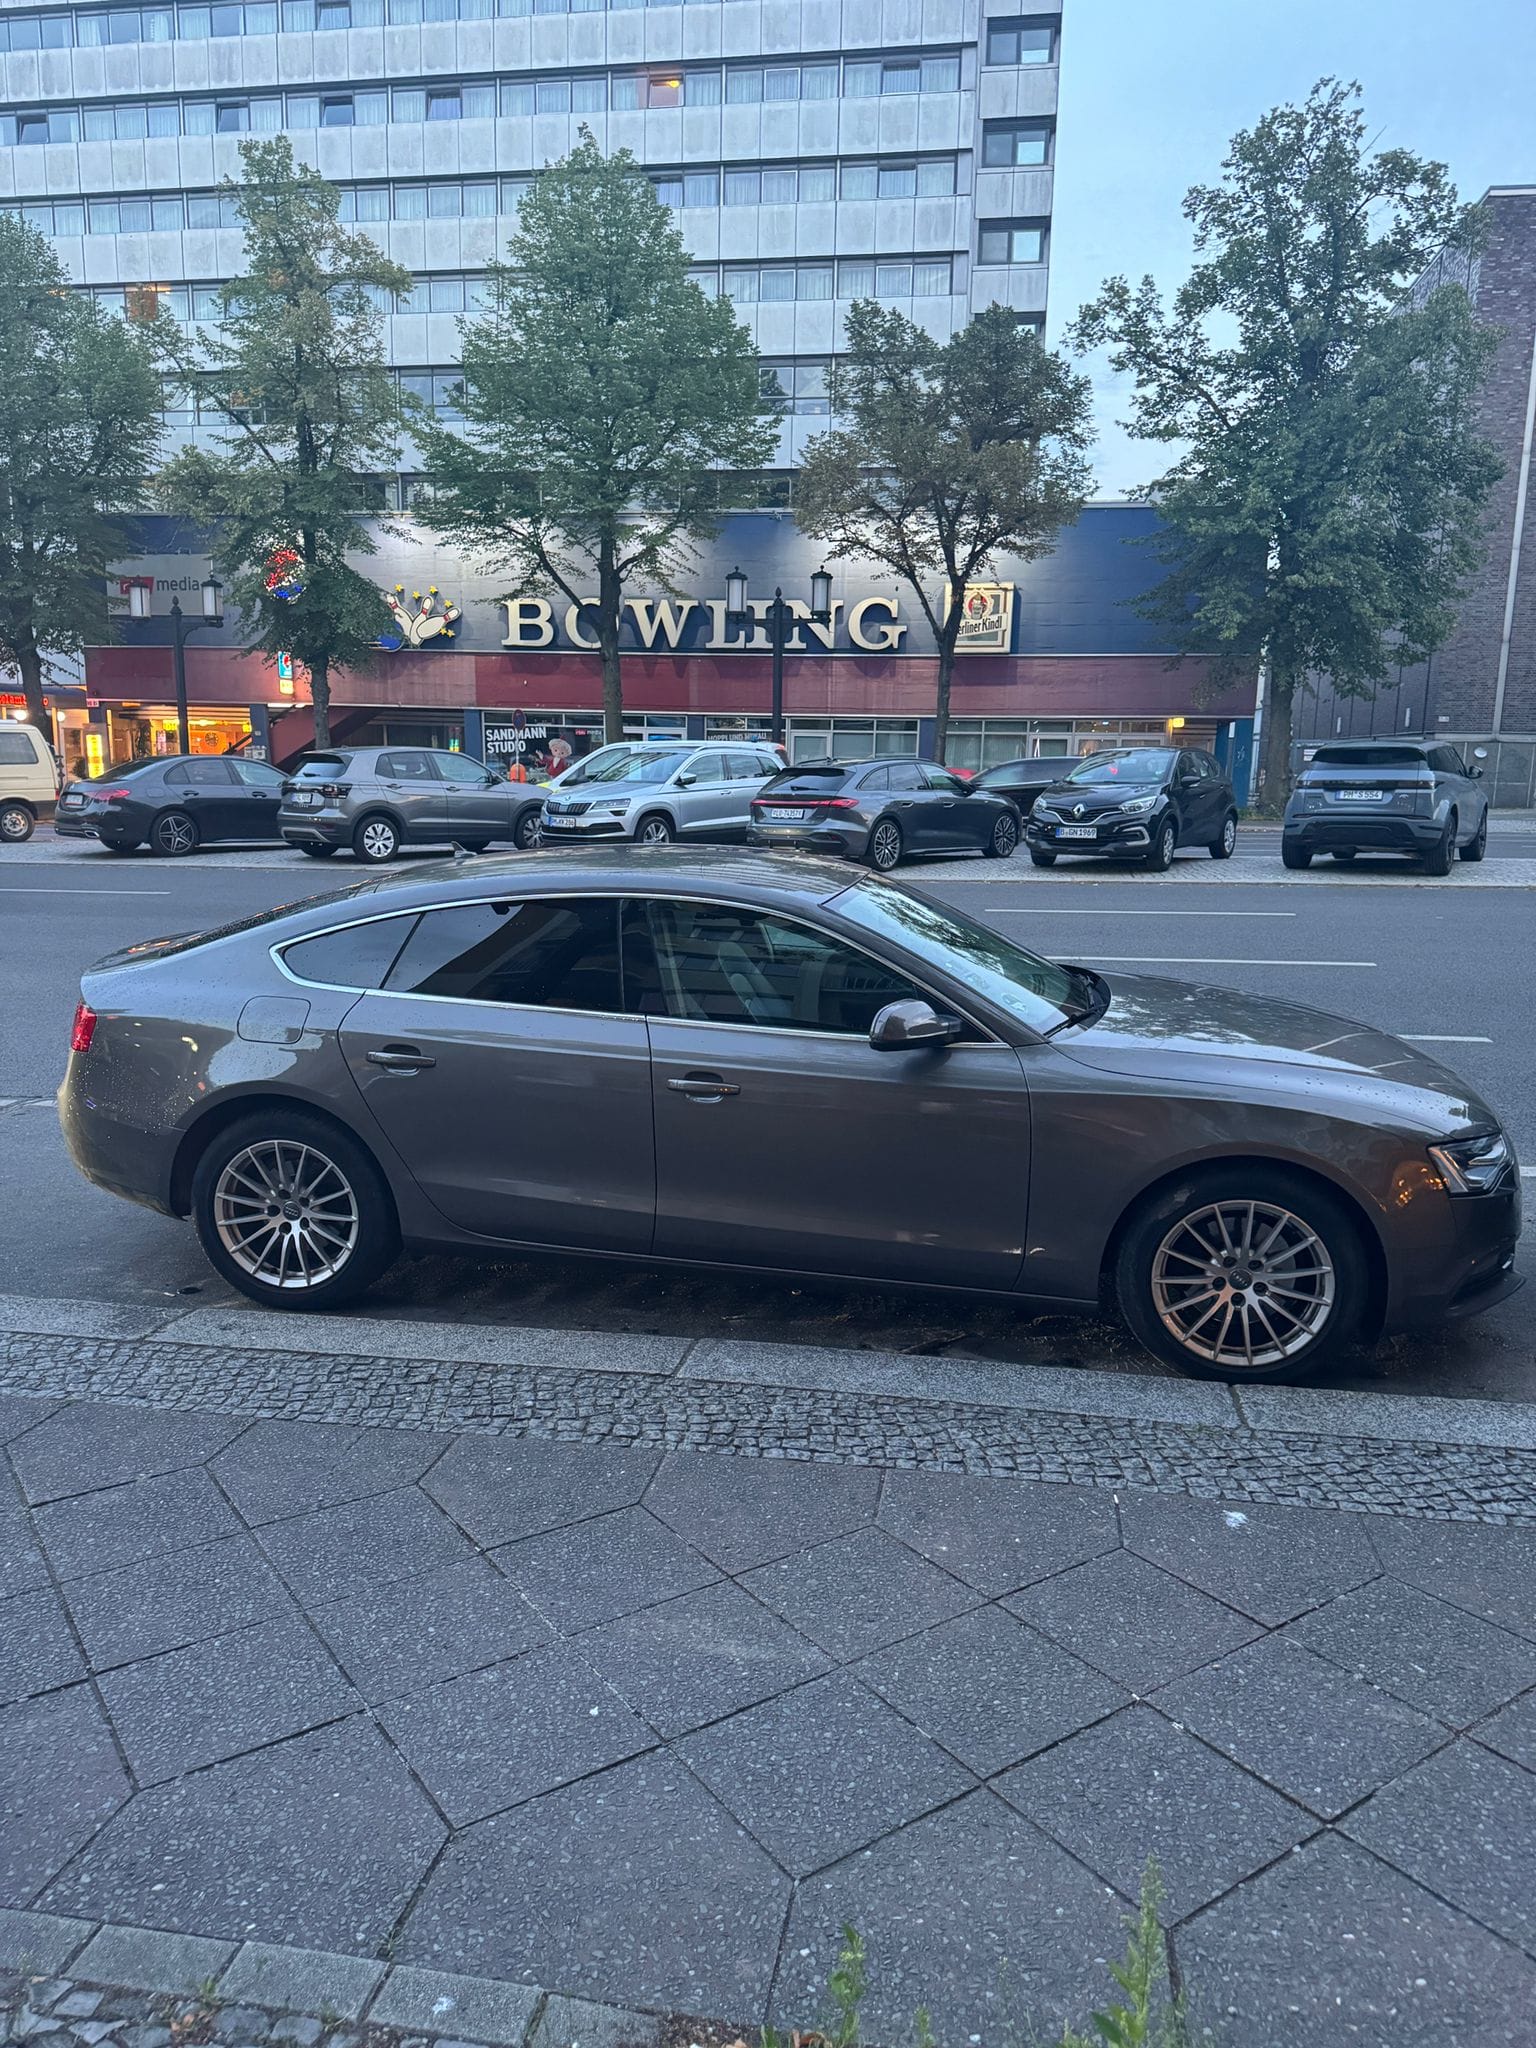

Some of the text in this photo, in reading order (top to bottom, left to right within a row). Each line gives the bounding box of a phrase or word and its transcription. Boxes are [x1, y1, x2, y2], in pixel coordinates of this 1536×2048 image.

[156, 577, 200, 591] media
[500, 597, 908, 650] BOWLING
[956, 615, 1003, 635] erliner Kindl
[486, 727, 547, 741] SANDMANN
